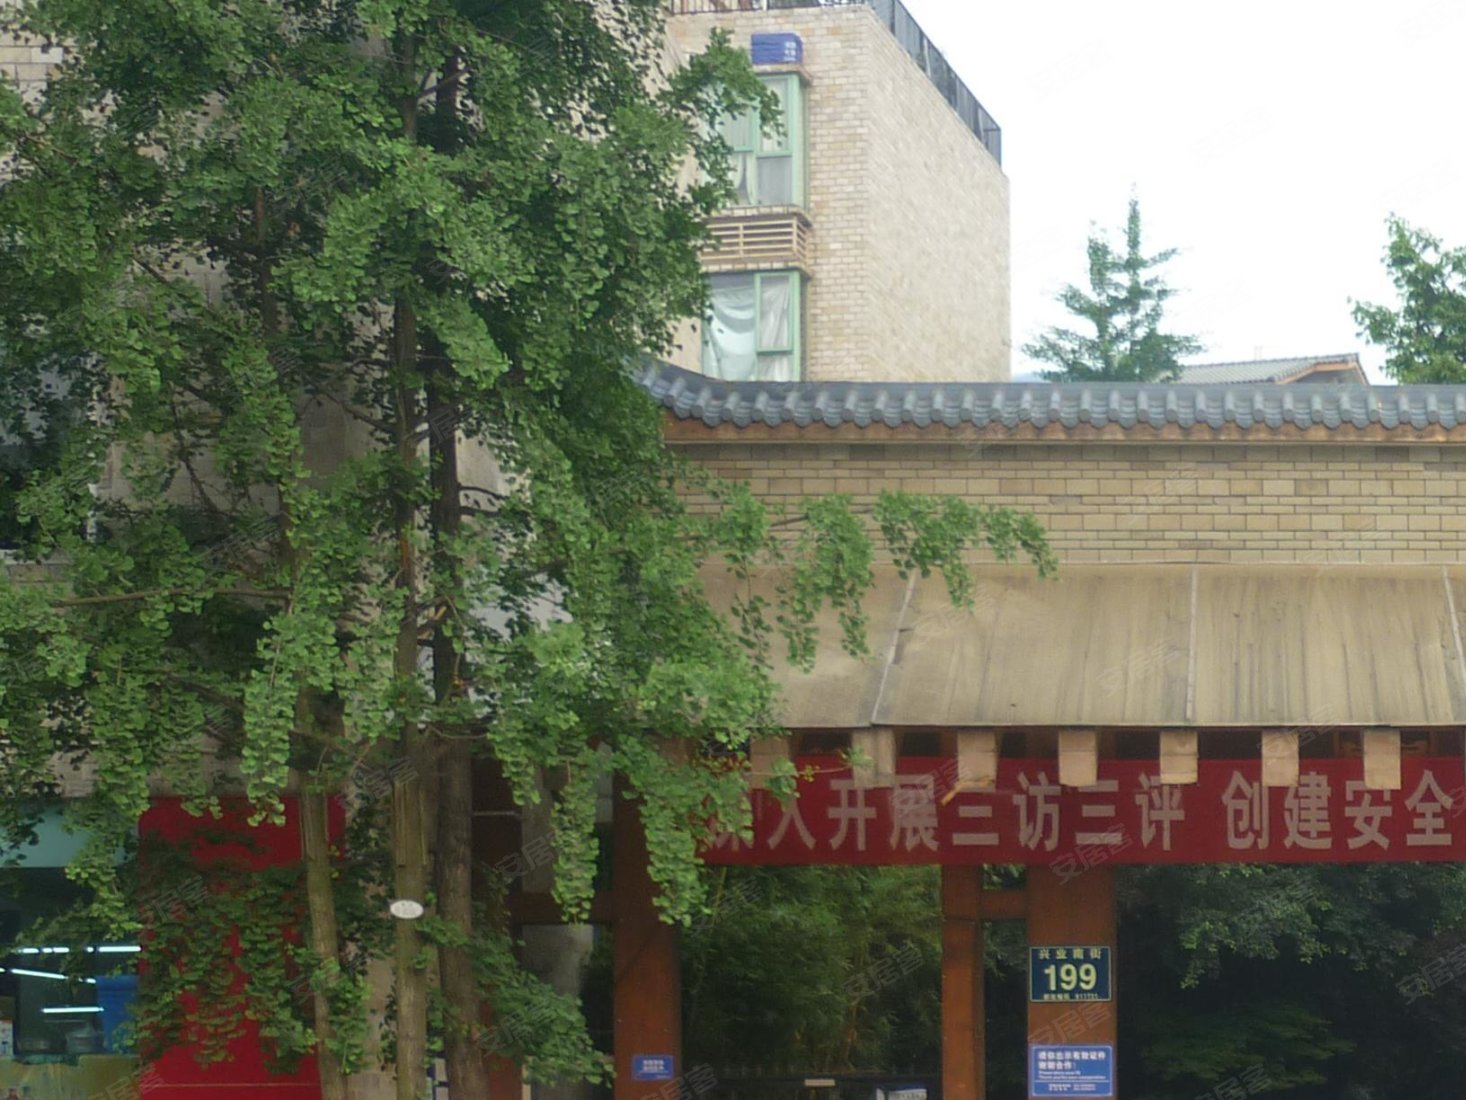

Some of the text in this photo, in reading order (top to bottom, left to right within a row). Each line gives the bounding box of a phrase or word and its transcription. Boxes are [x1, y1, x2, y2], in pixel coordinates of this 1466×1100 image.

[715, 771, 1186, 851] 入开展三访三评
[1044, 963, 1097, 991] 199
